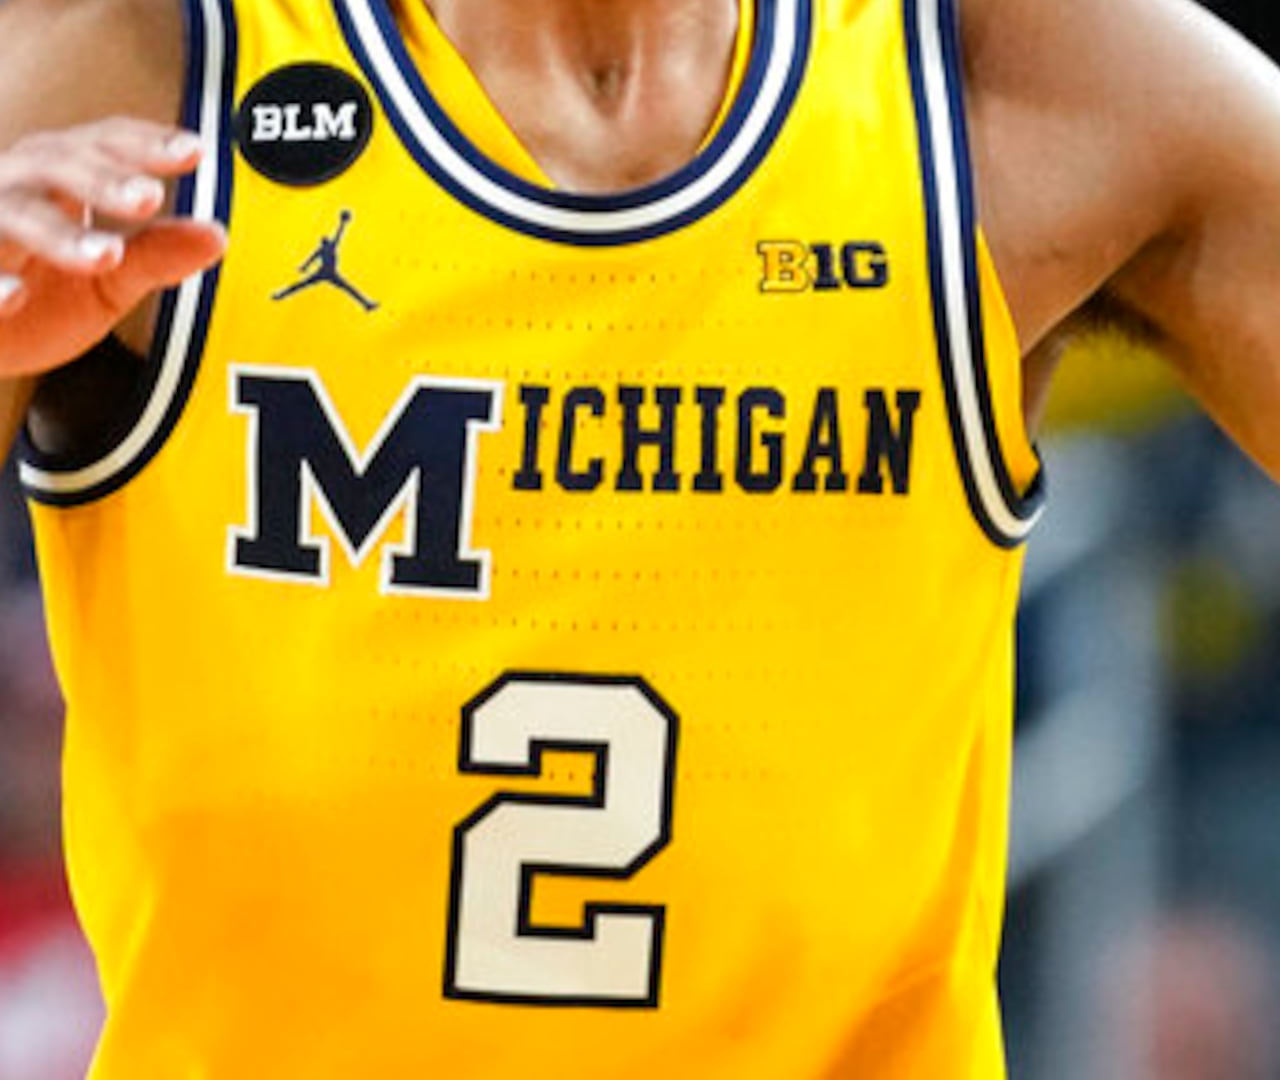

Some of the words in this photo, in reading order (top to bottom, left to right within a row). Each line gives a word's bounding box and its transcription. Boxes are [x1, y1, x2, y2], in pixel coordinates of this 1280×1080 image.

[251, 100, 357, 142] BLM
[226, 364, 921, 600] MICHIGAN
[442, 669, 680, 1009] 2
